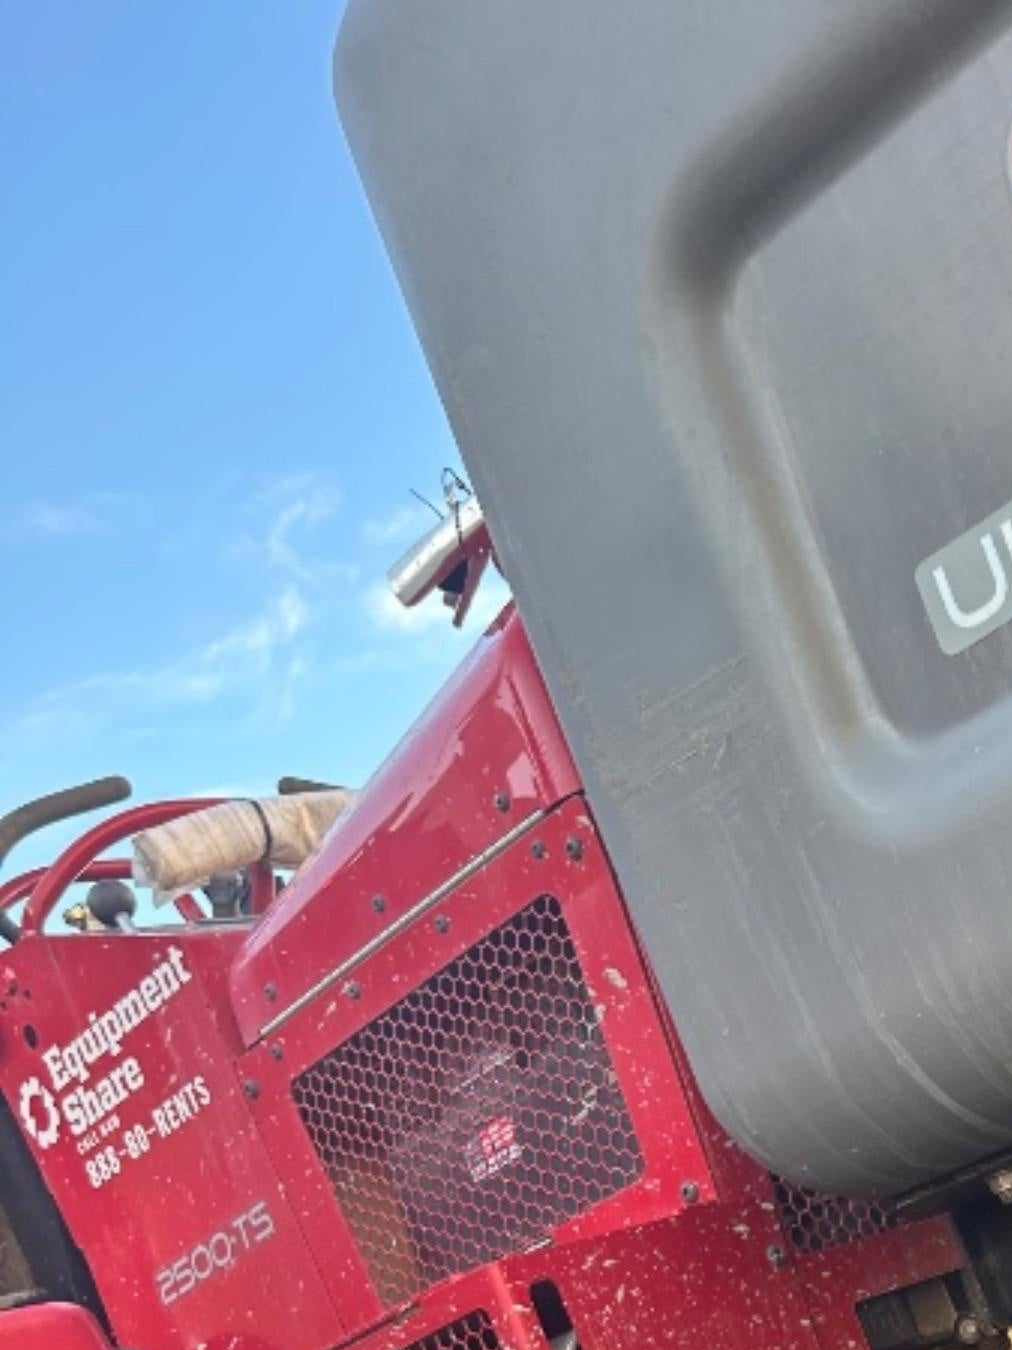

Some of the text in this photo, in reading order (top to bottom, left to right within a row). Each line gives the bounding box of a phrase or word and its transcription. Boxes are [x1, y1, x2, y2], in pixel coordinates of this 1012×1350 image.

[41, 945, 192, 1092] Equipment
[62, 1057, 144, 1135] Share
[86, 1075, 211, 1188] 888-80-RENTS
